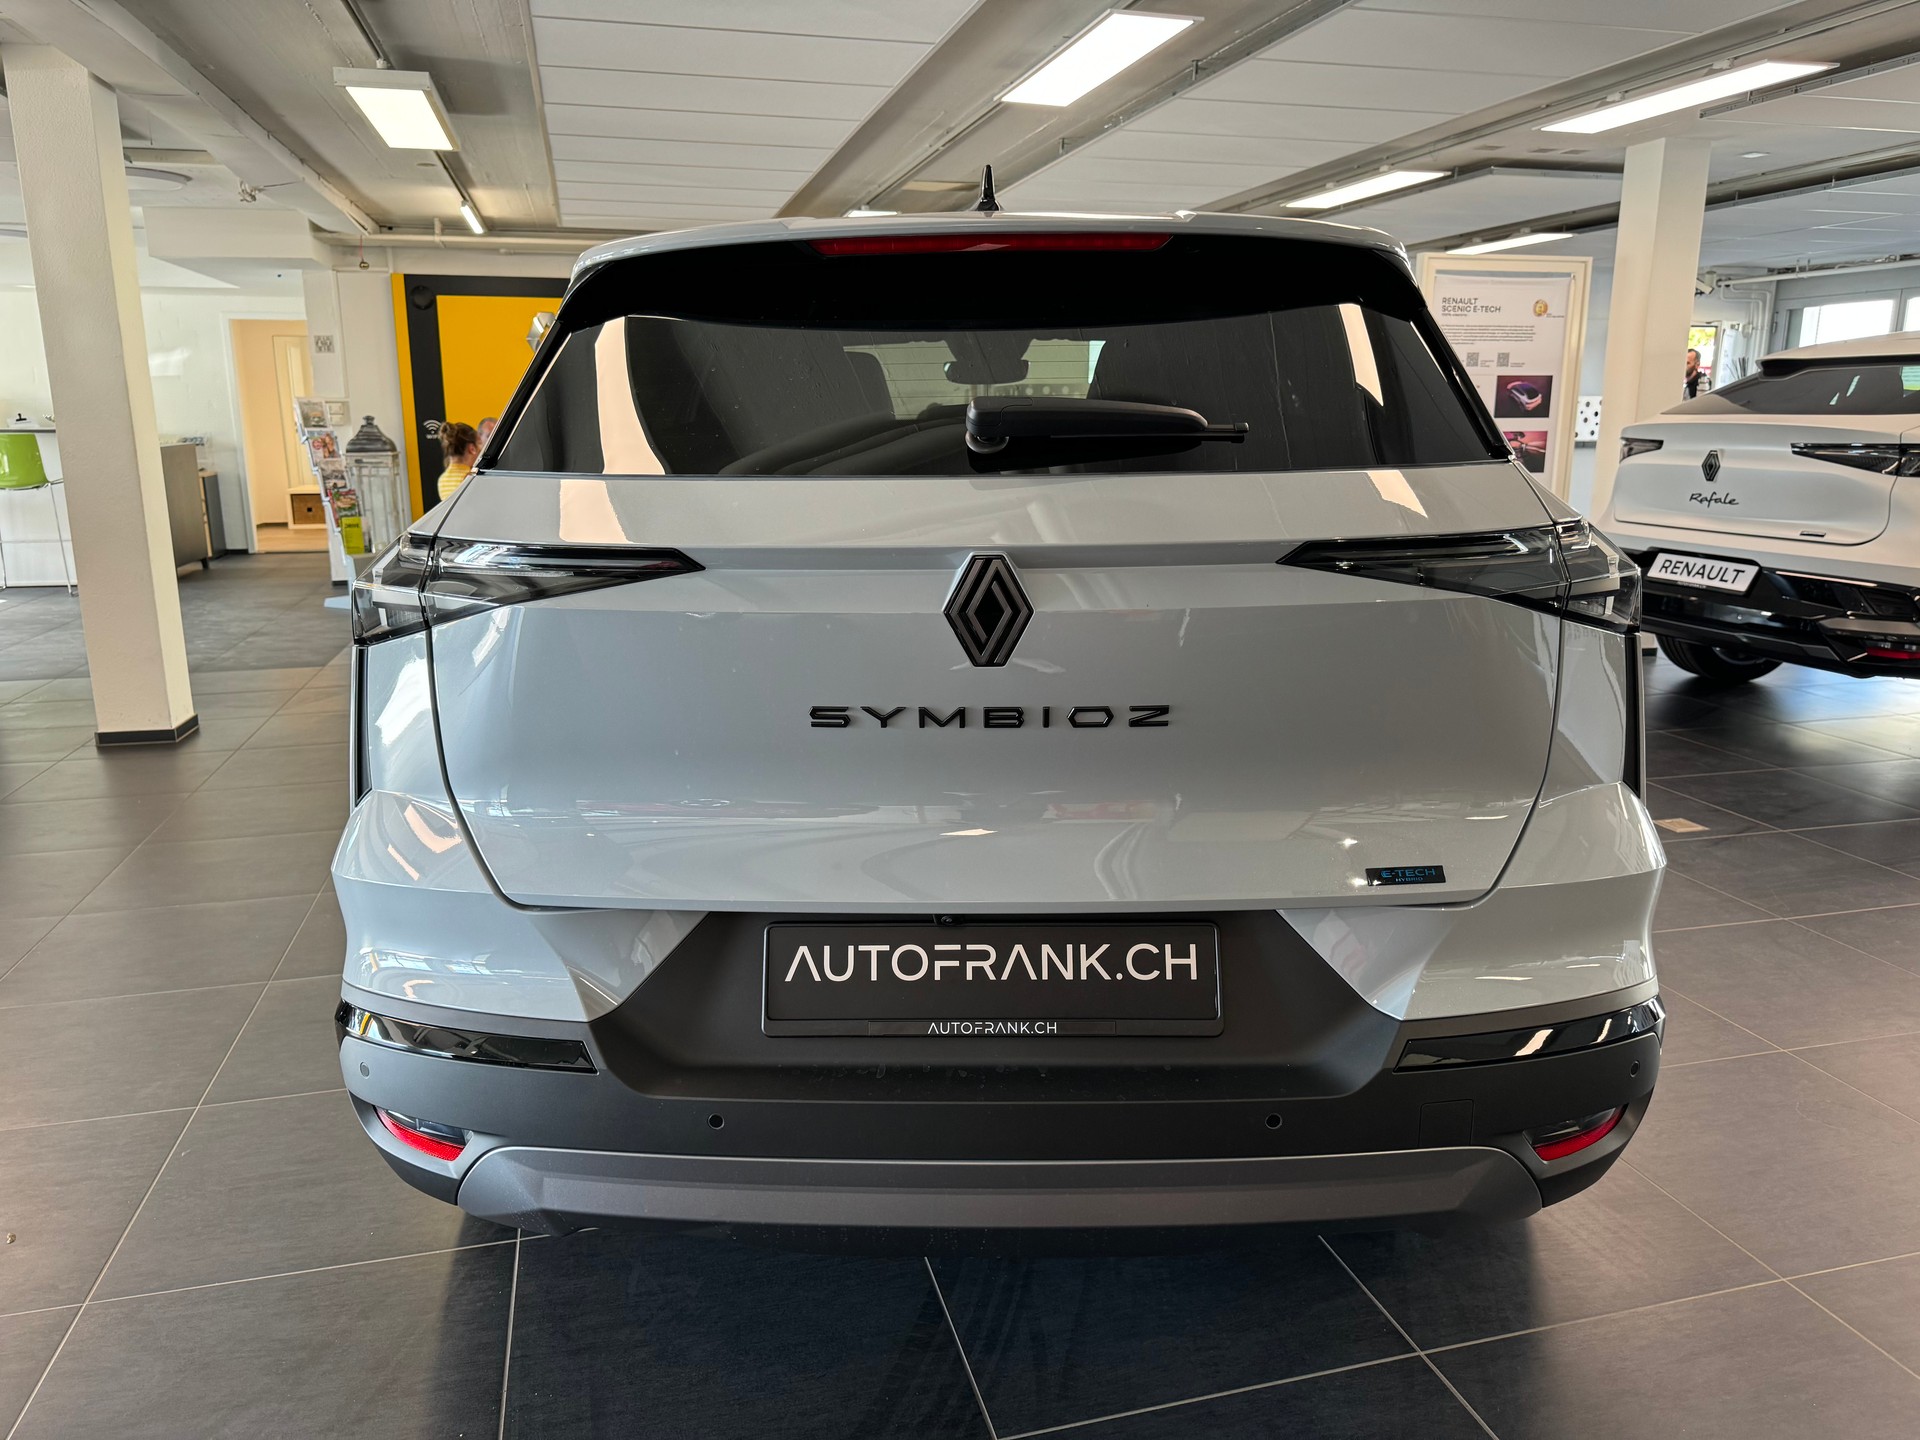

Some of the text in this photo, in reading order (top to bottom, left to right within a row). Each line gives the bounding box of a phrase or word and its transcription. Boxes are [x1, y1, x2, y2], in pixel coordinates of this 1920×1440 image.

[1441, 297, 1478, 305] RENAULT
[1441, 305, 1471, 313] SCENIC
[1689, 491, 1740, 509] Rafale
[1658, 559, 1745, 584] RENAULT
[808, 704, 1172, 729] SYMBIOZ
[1380, 868, 1436, 878] E-TECH
[784, 942, 1198, 983] AUTOFRANK.CH
[926, 1021, 1058, 1036] AUTOFRANK.CH
